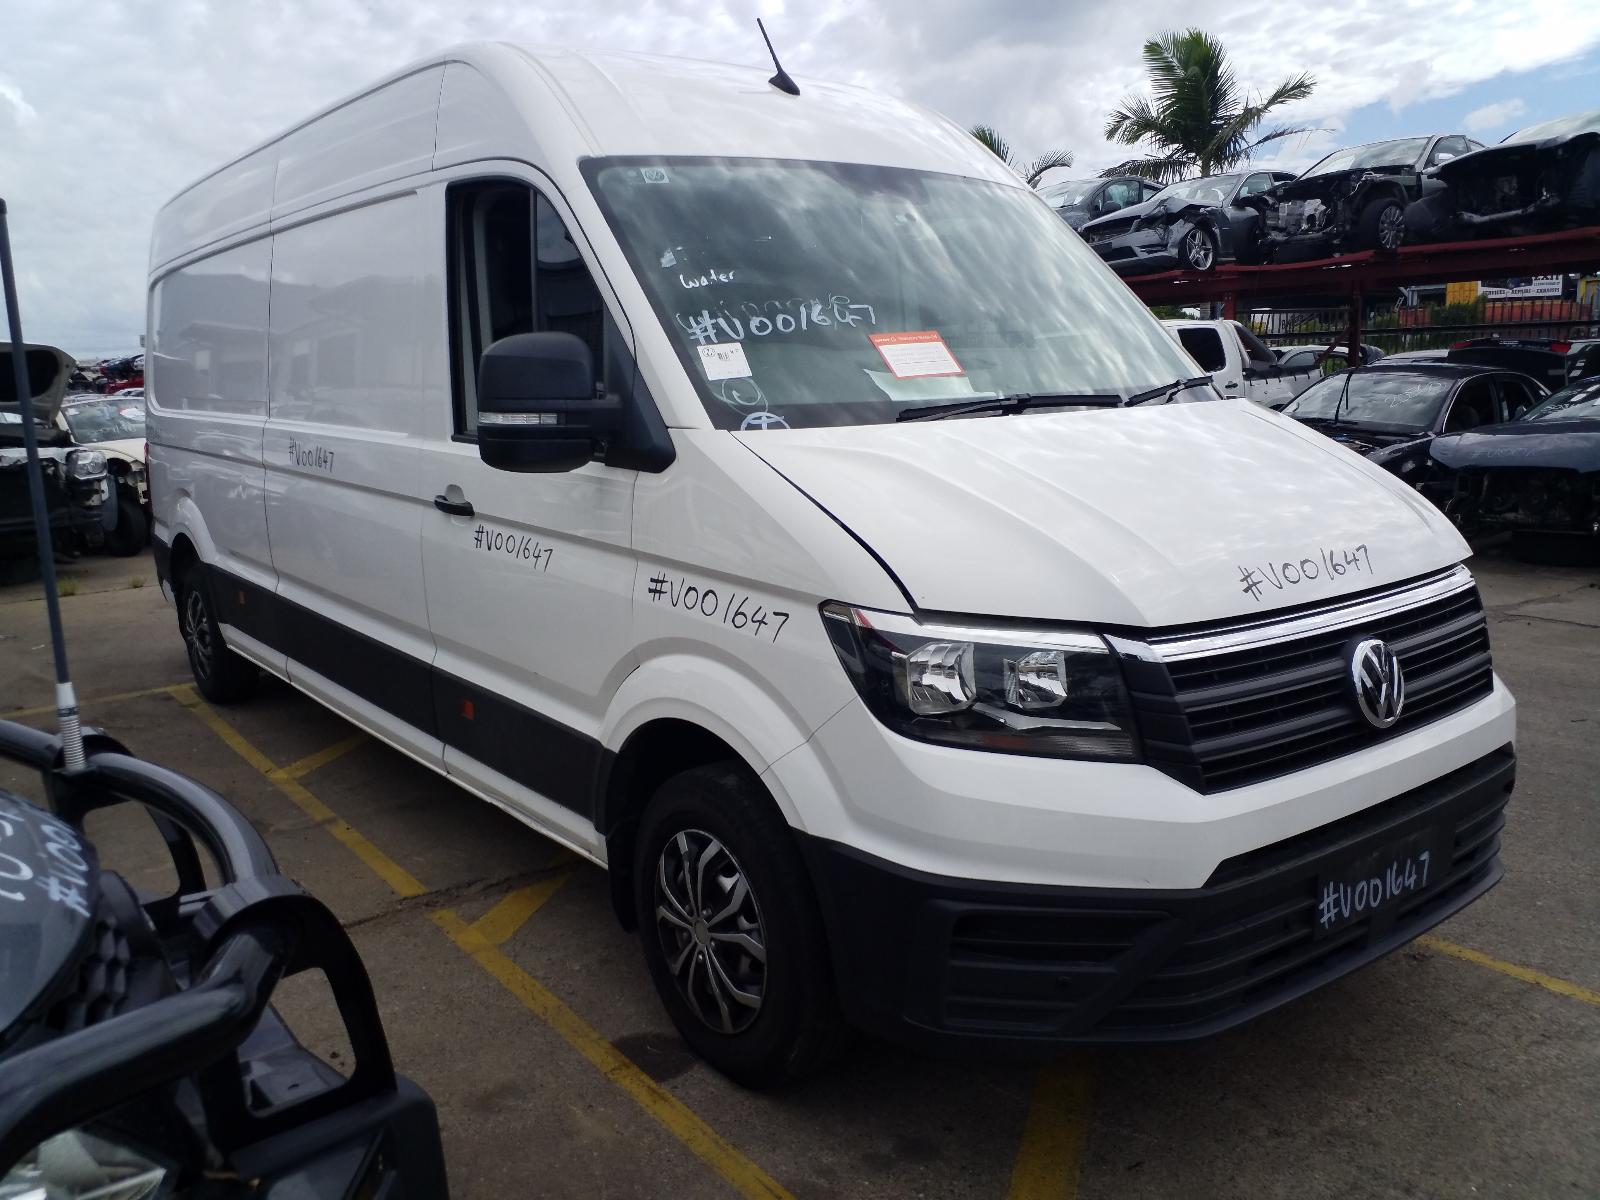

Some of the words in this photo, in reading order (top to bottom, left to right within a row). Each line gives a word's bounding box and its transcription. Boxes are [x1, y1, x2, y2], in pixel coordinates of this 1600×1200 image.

[288, 436, 335, 473] #V001647
[474, 524, 554, 573] #V001647
[1237, 543, 1374, 602] #V001647
[647, 571, 790, 644] #V001647
[1318, 850, 1431, 930] #V001647
